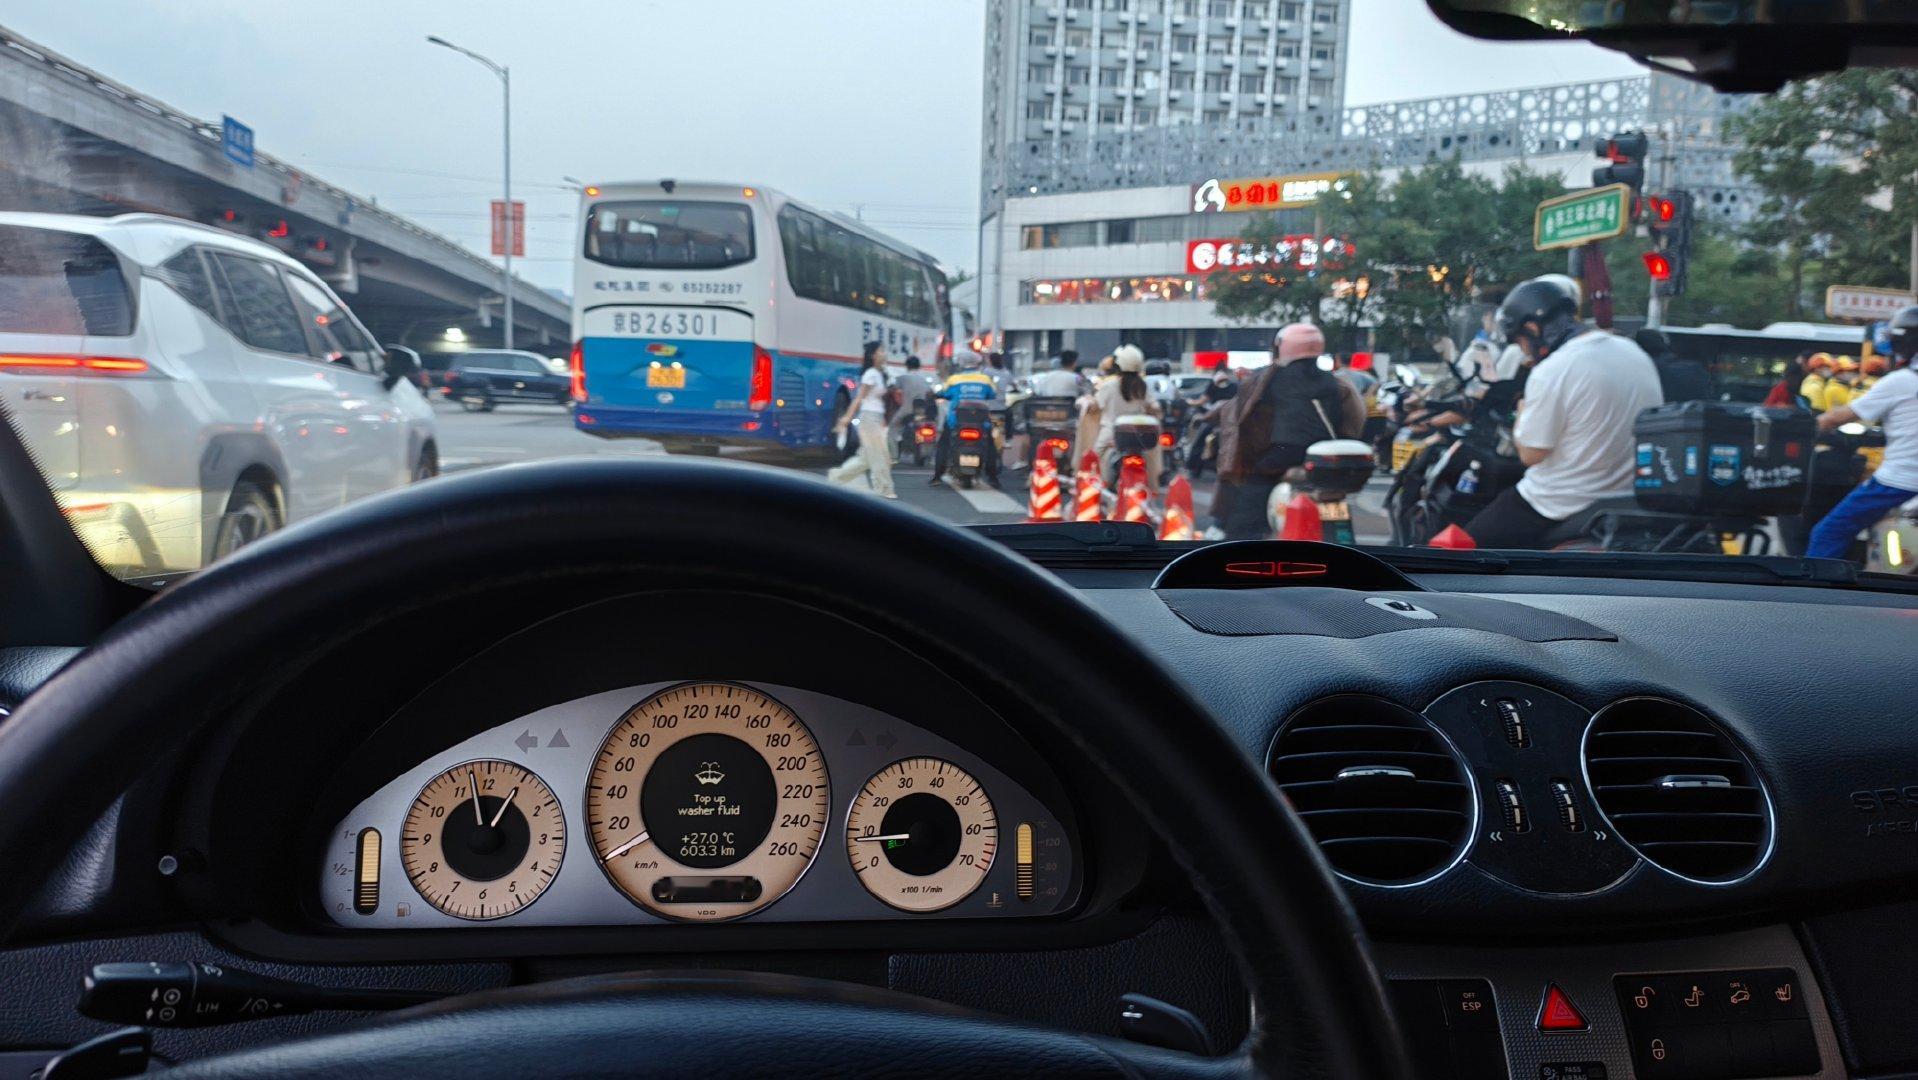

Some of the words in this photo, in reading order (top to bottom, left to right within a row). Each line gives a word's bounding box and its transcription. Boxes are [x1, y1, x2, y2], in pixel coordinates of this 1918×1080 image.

[684, 705, 708, 718] 120
[715, 705, 740, 718] 140
[652, 715, 678, 728] 100
[745, 715, 771, 728] 160
[630, 734, 650, 747] 80
[766, 734, 790, 747] 180
[615, 757, 634, 771] 60
[776, 757, 806, 770] 200
[482, 779, 495, 790] 12
[898, 778, 913, 788] 30
[930, 778, 944, 788] 40
[454, 787, 466, 798] 11
[606, 785, 628, 799] 40
[782, 785, 812, 798] 220
[694, 794, 711, 805] Top
[713, 795, 726, 805] up
[873, 796, 888, 807] 20
[955, 796, 969, 806] 50
[430, 806, 444, 817] 10
[533, 806, 541, 817] 2
[677, 805, 715, 815] washer
[717, 805, 740, 815] fluid
[608, 816, 630, 830] 20
[780, 814, 810, 828] 240
[863, 826, 875, 837] 10
[965, 824, 981, 835] 60
[423, 834, 432, 845] 9
[538, 834, 547, 845] 3
[681, 832, 719, 844] +27.0
[722, 831, 734, 844] °C
[680, 845, 717, 856] 603.3
[721, 845, 735, 856] km
[768, 842, 798, 856] 260
[531, 861, 538, 871] 4
[634, 859, 658, 870] km/h
[870, 855, 879, 867] 0
[959, 855, 974, 866] 70
[429, 862, 438, 873] 8
[452, 881, 461, 892] 7
[508, 881, 517, 892] 5
[922, 885, 943, 893] 1/min
[479, 888, 487, 899] 6
[337, 902, 344, 912] 0
[1462, 1002, 1482, 1011] ESP
